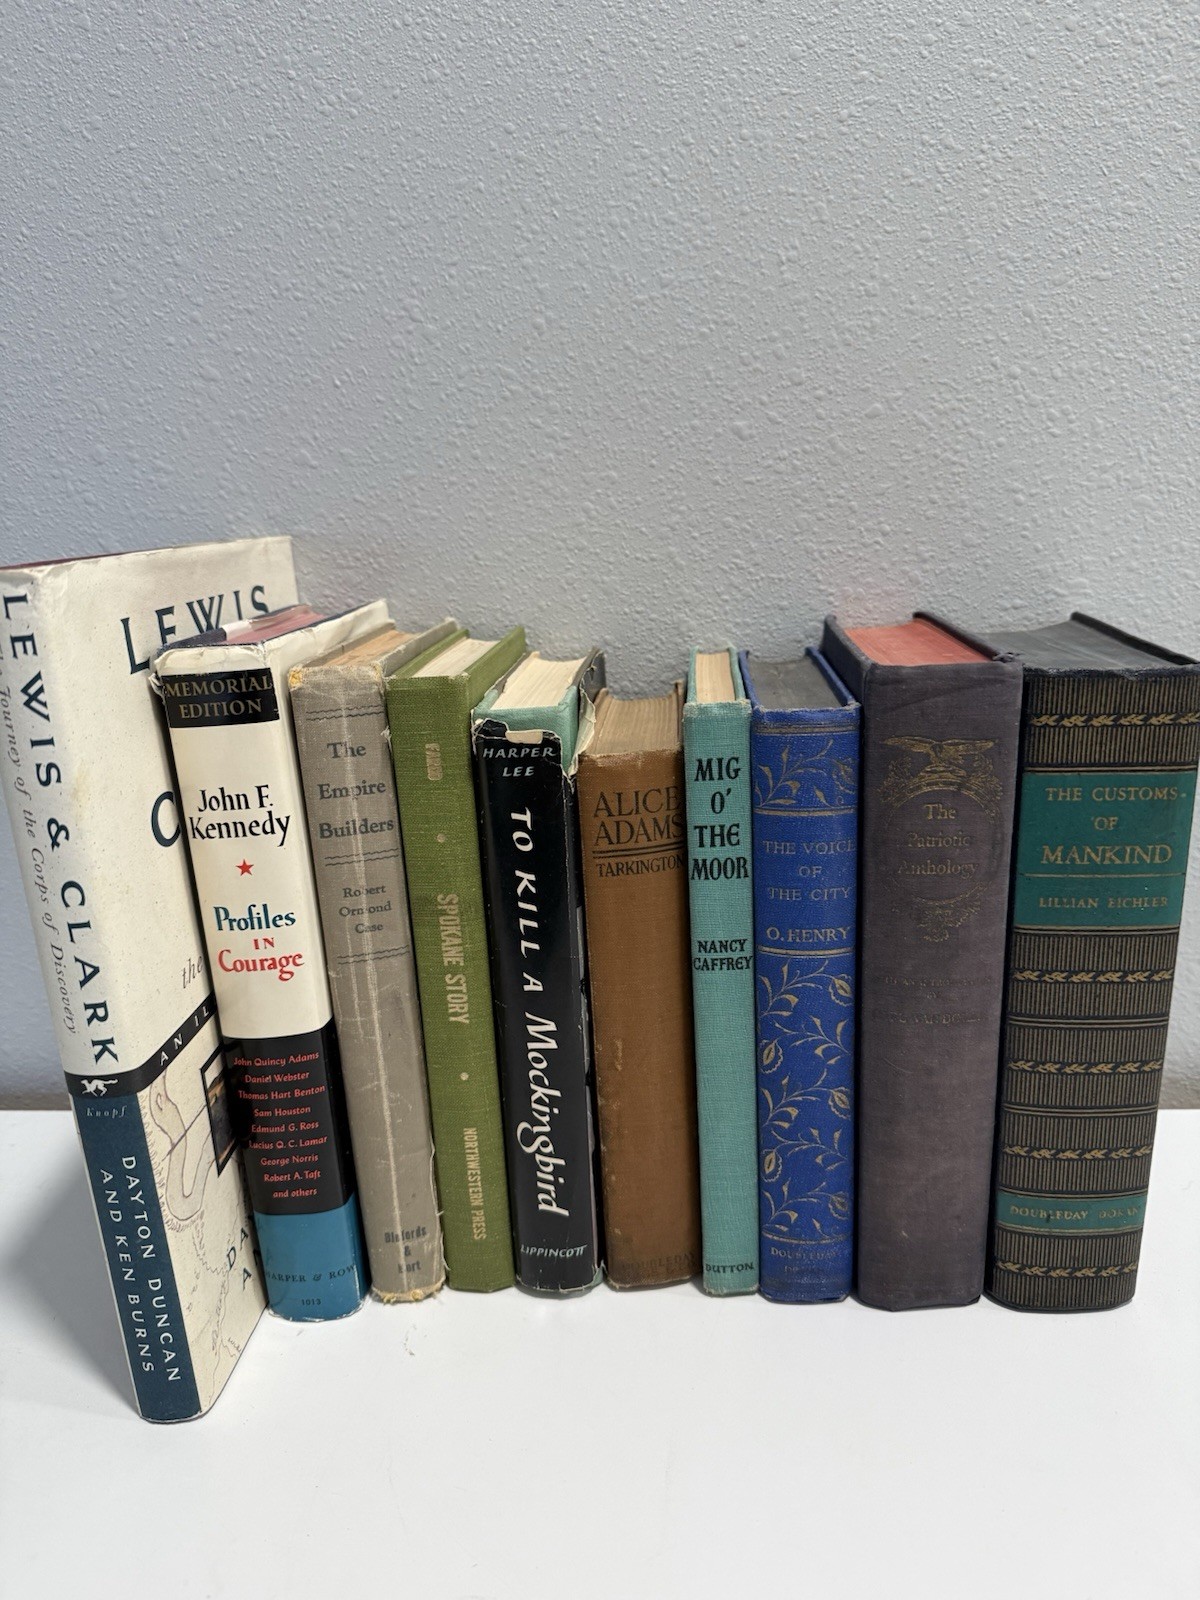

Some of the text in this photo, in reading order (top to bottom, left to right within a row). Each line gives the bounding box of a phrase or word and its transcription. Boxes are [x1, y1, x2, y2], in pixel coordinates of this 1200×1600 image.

[120, 585, 270, 675] LEWIS
[165, 674, 273, 699] MEMORIAL
[179, 698, 263, 720] EDITION
[327, 741, 367, 760] The
[482, 747, 557, 759] HARPER
[502, 766, 535, 778] LEE
[694, 757, 740, 782] MIG
[14, 776, 31, 801] of
[197, 783, 274, 813] John F.
[318, 779, 387, 801] Empire
[1044, 786, 1178, 801] THE CUSTOMS
[593, 785, 681, 818] ALICE
[711, 788, 731, 814] O'
[923, 803, 956, 820] The
[2, 593, 119, 1065] LEWIS & CLARK
[189, 810, 291, 848] Kennedy
[319, 816, 395, 841] Builders
[594, 814, 684, 846] ADAMS
[1093, 817, 1118, 831] OF
[694, 823, 740, 848] THE
[763, 840, 796, 854] THE
[1040, 844, 1172, 865] MANKIND
[595, 853, 685, 878] TARKINGTON
[690, 857, 749, 881] MOOR
[799, 866, 822, 878] OF
[31, 847, 50, 905] Corps
[767, 886, 851, 901] THE CITY
[1039, 897, 1168, 909] LILLIAN EICHLER
[42, 911, 59, 935] of
[213, 903, 297, 932] Profiles
[253, 936, 276, 951] IN
[766, 926, 851, 942] O. HENRY
[697, 938, 747, 953] NANCY
[218, 948, 305, 983] Courage
[436, 894, 470, 1025] SPOKANE STORY
[693, 956, 753, 971] CAFFREY
[50, 942, 76, 1034] Discovery
[510, 806, 571, 1218] TO KILL A Mockingbird
[233, 1051, 320, 1068] John Quincy Adams
[245, 1072, 311, 1084] Daniel Webster
[238, 1084, 327, 1101] Thomas Hart Benton
[86, 1105, 127, 1118] Knopf
[254, 1105, 312, 1118] Sam Houston
[252, 1120, 320, 1134] Edmund G. Ross
[250, 1135, 328, 1150] Lucius Q. C. Lamar
[260, 1153, 319, 1168] George Norris
[264, 1169, 321, 1183] Robert A. Taft
[463, 1127, 487, 1240] NORTHWESTERN PRESS
[273, 1186, 318, 1198] and others
[520, 1244, 587, 1258] LIPPINCOTT
[100, 1168, 154, 1373] AND KEN BURNS
[122, 1155, 181, 1382] DAYTON DUNCAN
[313, 1273, 323, 1282] &
[705, 1262, 754, 1274] DUTTON
[301, 1298, 322, 1306] 1013
